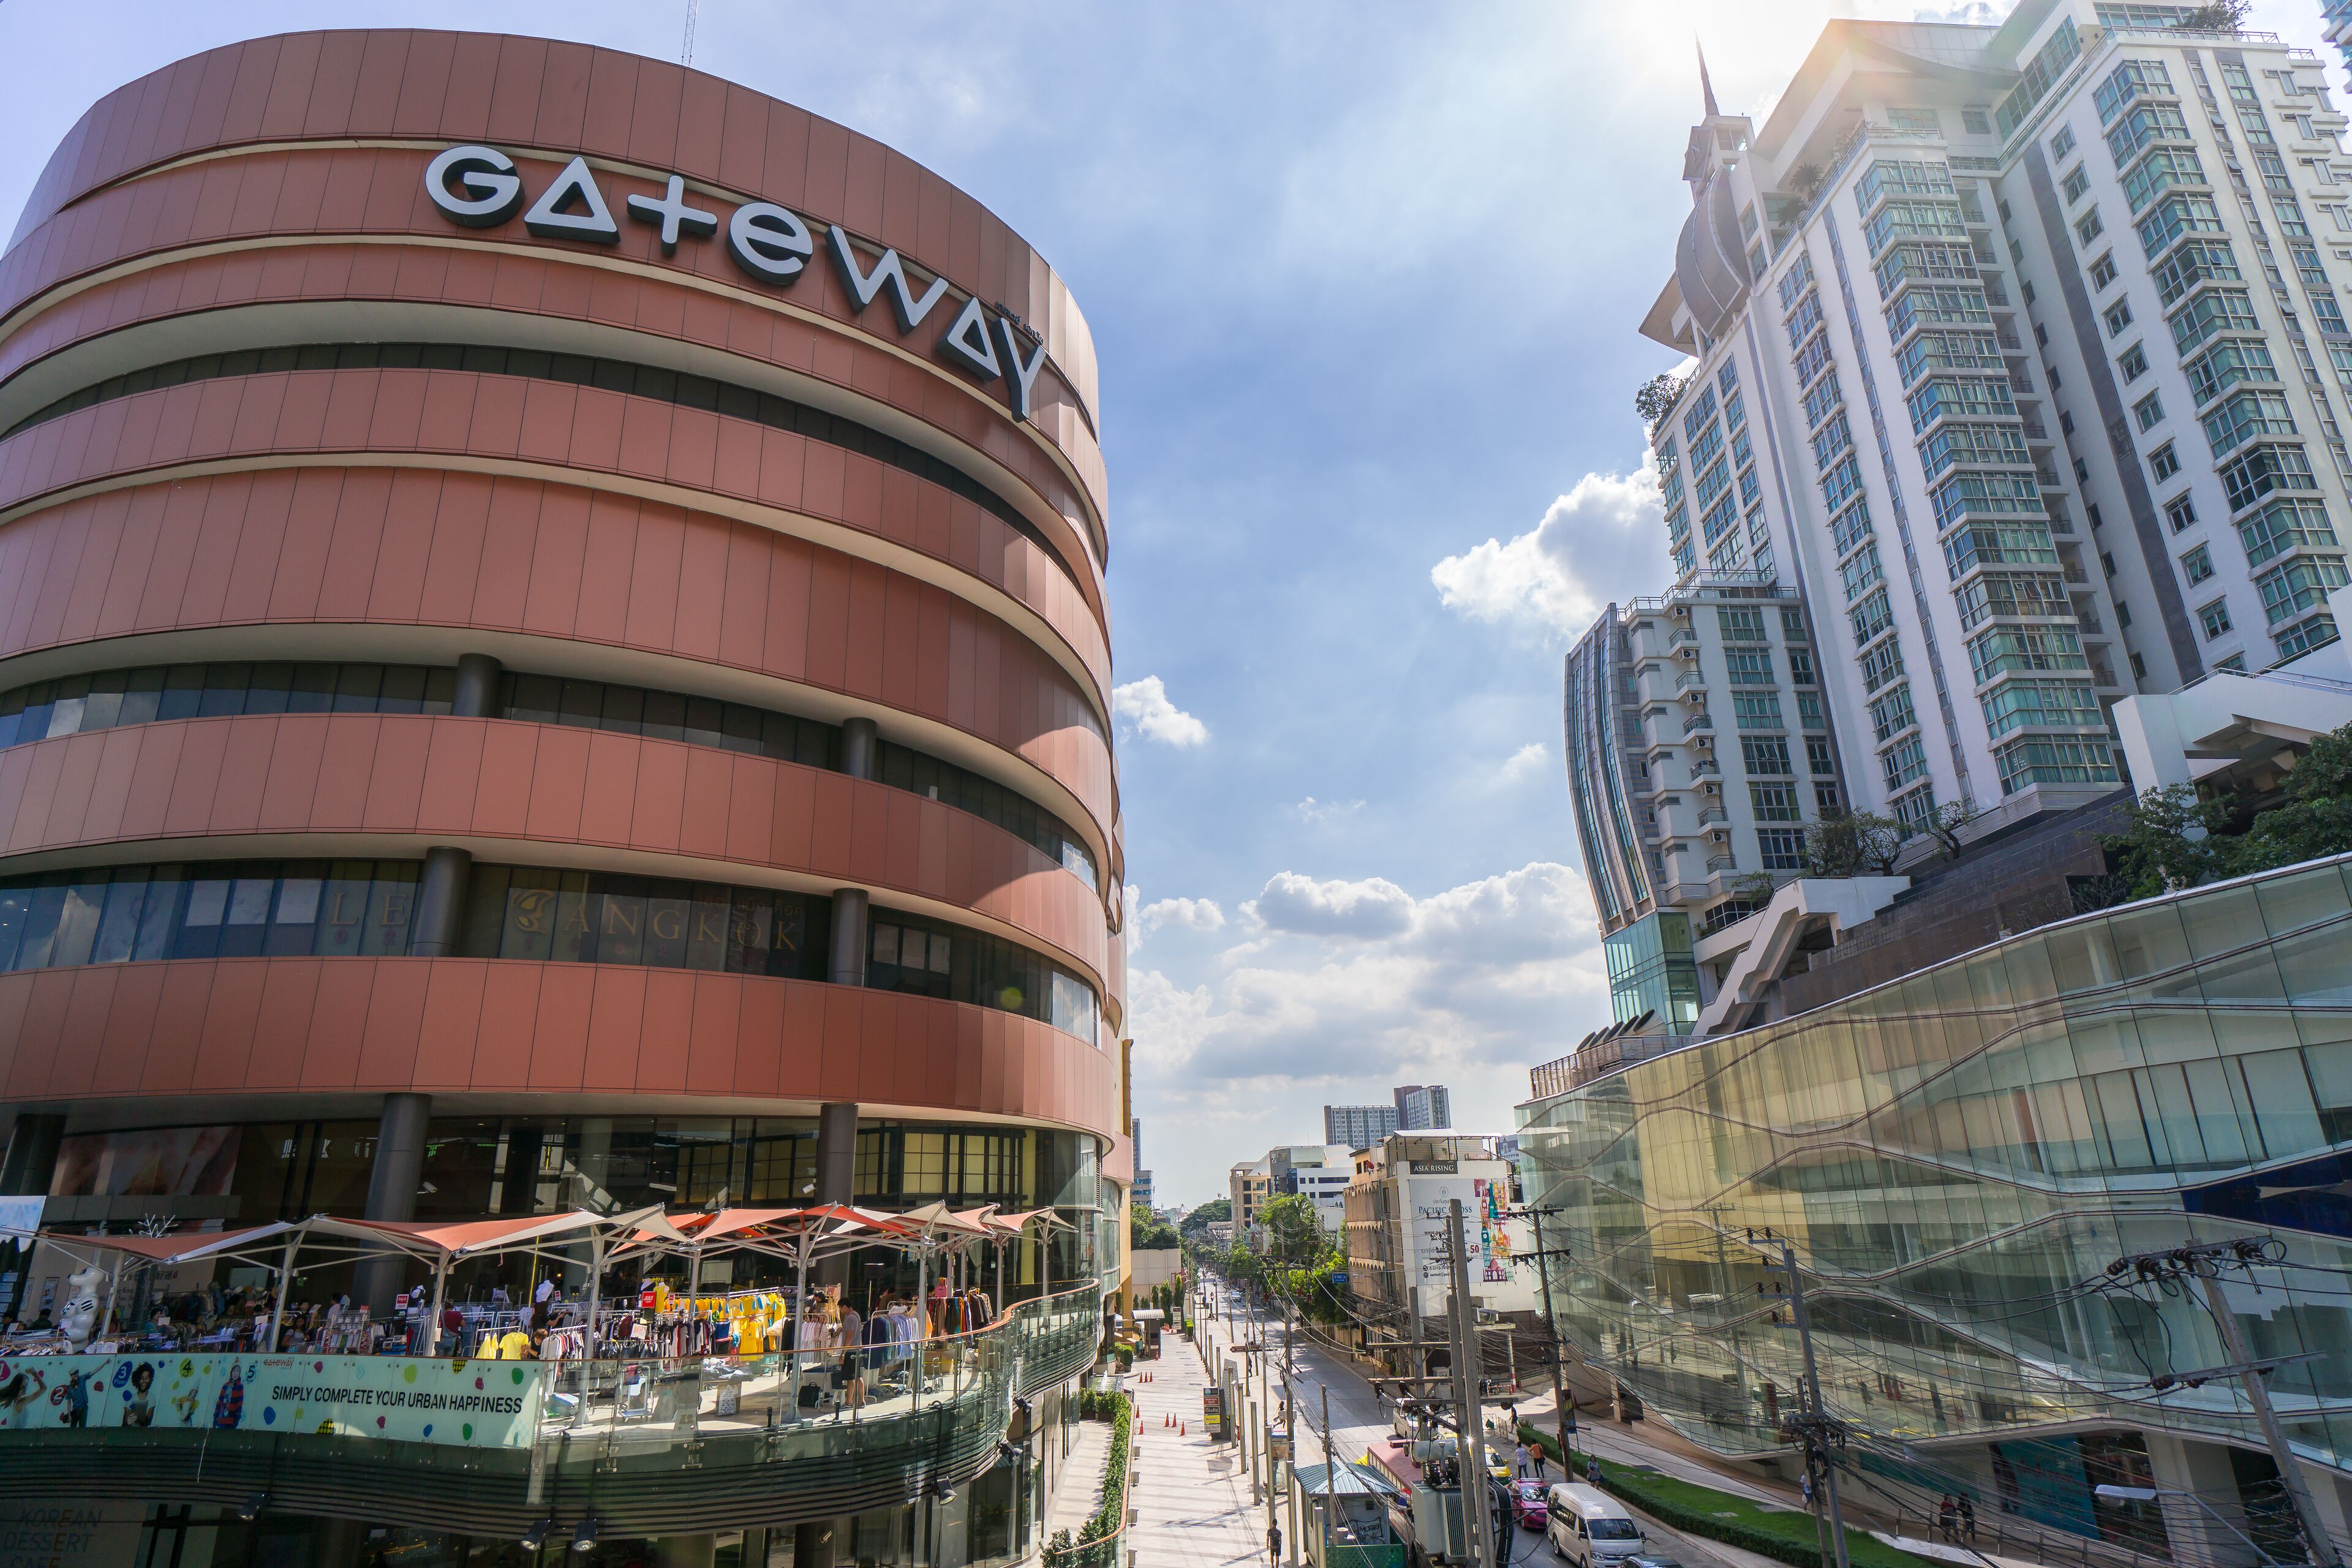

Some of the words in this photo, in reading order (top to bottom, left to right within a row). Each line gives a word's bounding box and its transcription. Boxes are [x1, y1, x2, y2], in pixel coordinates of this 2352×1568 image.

[1470, 1245, 1479, 1254] 50
[118, 1366, 127, 1379] 3
[183, 1360, 192, 1373] 4
[247, 1365, 255, 1379] 5
[53, 1387, 64, 1401] 2
[272, 1385, 313, 1401] SIMPLY
[314, 1387, 374, 1404] COMPLETE
[376, 1390, 405, 1407] YOUR
[407, 1392, 447, 1410] URBAN
[449, 1394, 522, 1414] HAPPINESS
[17, 1509, 103, 1528] KOREAN
[4, 1531, 93, 1552] DESSERT
